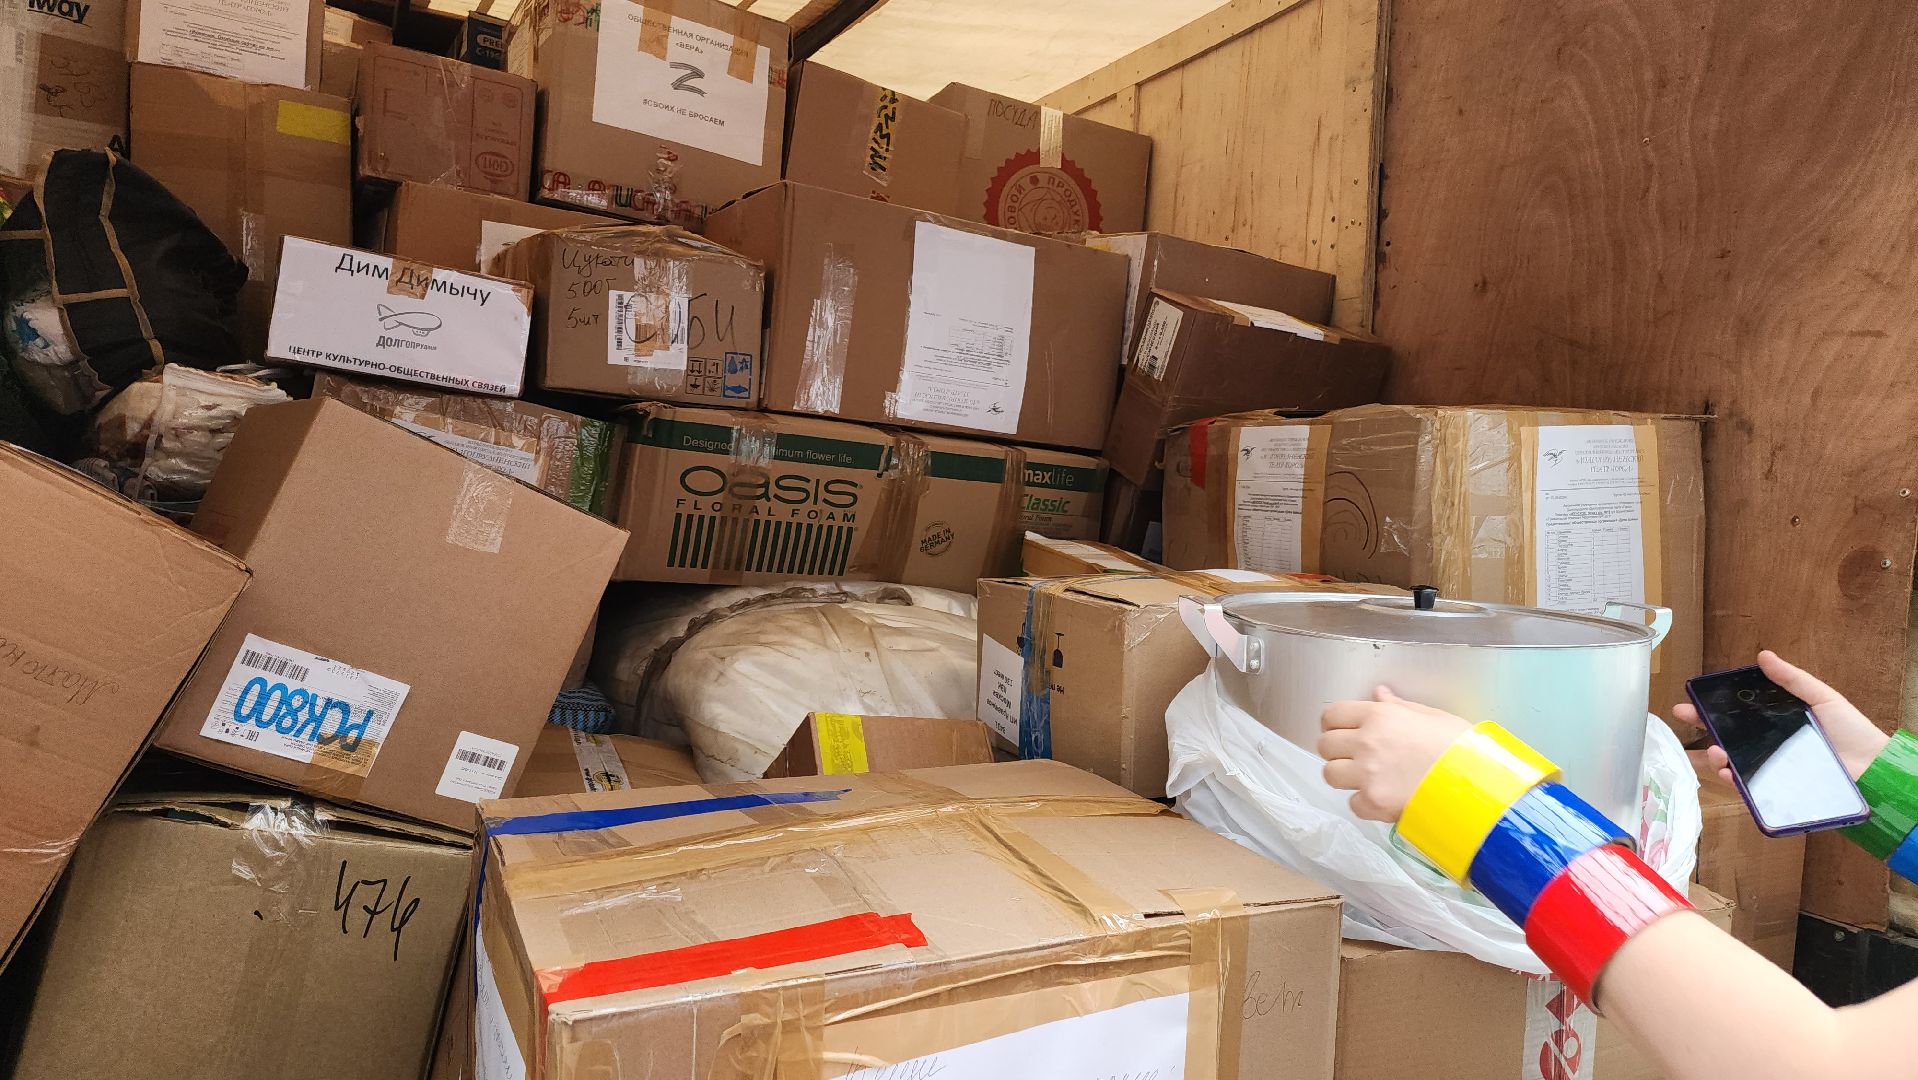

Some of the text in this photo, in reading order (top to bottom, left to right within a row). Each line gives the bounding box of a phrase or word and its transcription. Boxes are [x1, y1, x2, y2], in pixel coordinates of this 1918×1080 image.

[669, 61, 708, 98] Z
[676, 106, 688, 117] НЕ
[688, 109, 726, 127] БРОСАЕМ
[988, 98, 1039, 130] ПОСУДА
[1006, 174, 1082, 229] ОВОЙ ПРОДУК
[334, 252, 492, 307] Дим Димычу
[288, 345, 507, 394] ЦЕНТР КУЛЬТУРНО-ОБЩЕСТВЕННЫХ СВЯЗЕЙ
[682, 435, 735, 452] Designed
[805, 449, 837, 463] flower
[838, 452, 856, 465] life.
[675, 498, 856, 524] FLORAL FOAM
[920, 527, 951, 547] MADE IN
